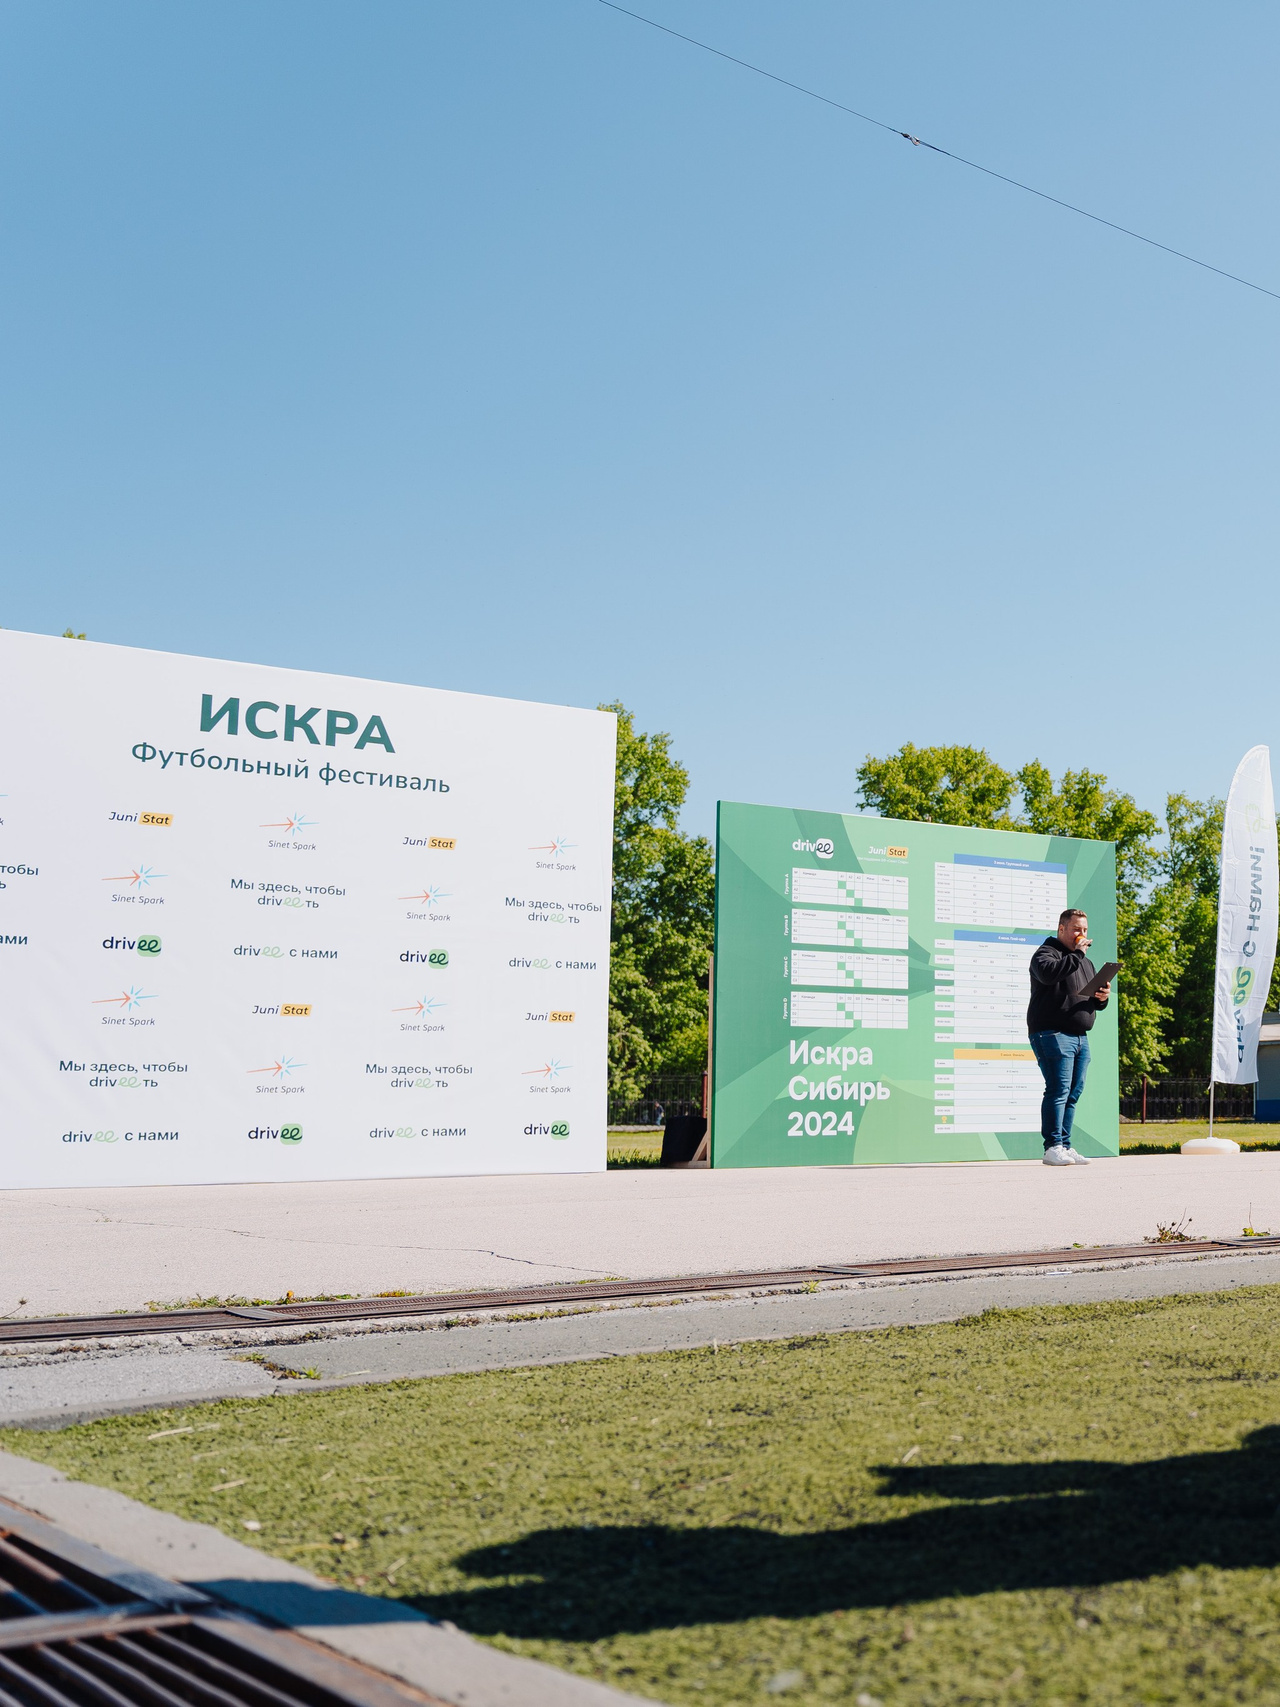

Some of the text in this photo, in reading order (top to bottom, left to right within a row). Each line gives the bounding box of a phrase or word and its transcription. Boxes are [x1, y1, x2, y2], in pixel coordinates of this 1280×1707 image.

[200, 693, 396, 754] ИСКРА
[131, 742, 450, 793] Футбольный фестиваль
[108, 812, 170, 825] Juni Stat
[268, 840, 316, 851] Sinet Spark
[403, 837, 453, 849] Juni Stat
[792, 839, 834, 855] drivee
[868, 846, 906, 857] Juni Stat
[0, 863, 39, 876] тобы
[556, 863, 576, 871] Spark
[231, 879, 345, 896] Мы здесь, чтобы
[112, 894, 164, 905] Sinet Spark
[505, 897, 601, 913] Мы здесь, чтобы
[407, 912, 426, 920] Sinet
[0, 935, 28, 945] ами
[102, 936, 161, 953] drivee
[234, 945, 337, 959] drivee с нами
[400, 951, 449, 965] drivee
[509, 957, 551, 969] drivee
[566, 961, 596, 970] нами
[252, 1005, 308, 1016] Juni Stat
[525, 1012, 573, 1022] Juni Stat
[102, 1017, 155, 1027] Sinet Spark
[423, 1024, 445, 1032] Spark
[790, 1040, 873, 1071] Искра
[59, 1060, 187, 1074] Мы здесь, чтобы
[366, 1064, 472, 1075] Мы здесь, чтобы
[281, 1086, 305, 1094] Spark
[551, 1086, 571, 1094] Spark
[788, 1075, 890, 1106] Сибирь
[524, 1123, 570, 1137] drivee
[787, 1111, 854, 1136] 2024
[62, 1131, 178, 1143] drivee с нами
[248, 1127, 303, 1141] drivee
[370, 1127, 466, 1138] drivee с нами
